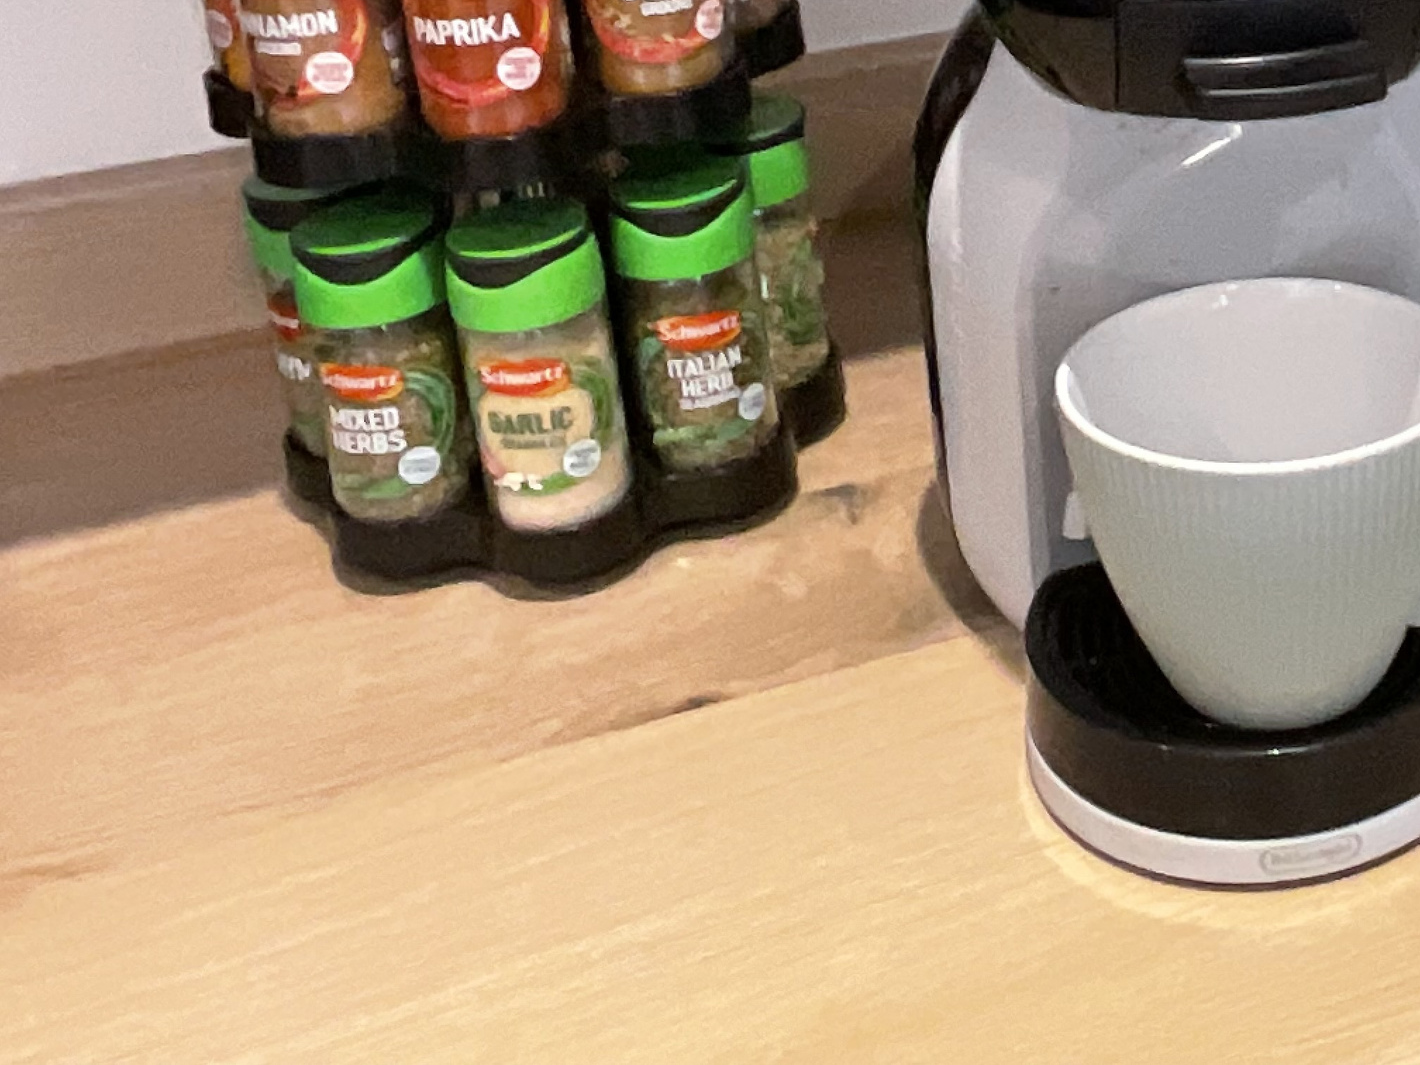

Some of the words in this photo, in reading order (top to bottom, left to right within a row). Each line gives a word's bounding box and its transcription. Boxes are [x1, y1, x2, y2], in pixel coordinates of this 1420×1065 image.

[412, 11, 521, 47] PAPRIKA
[666, 345, 742, 379] ITALIAN
[329, 405, 399, 431] MIXED
[487, 406, 574, 435] GARLIC
[333, 430, 408, 454] HERBS
